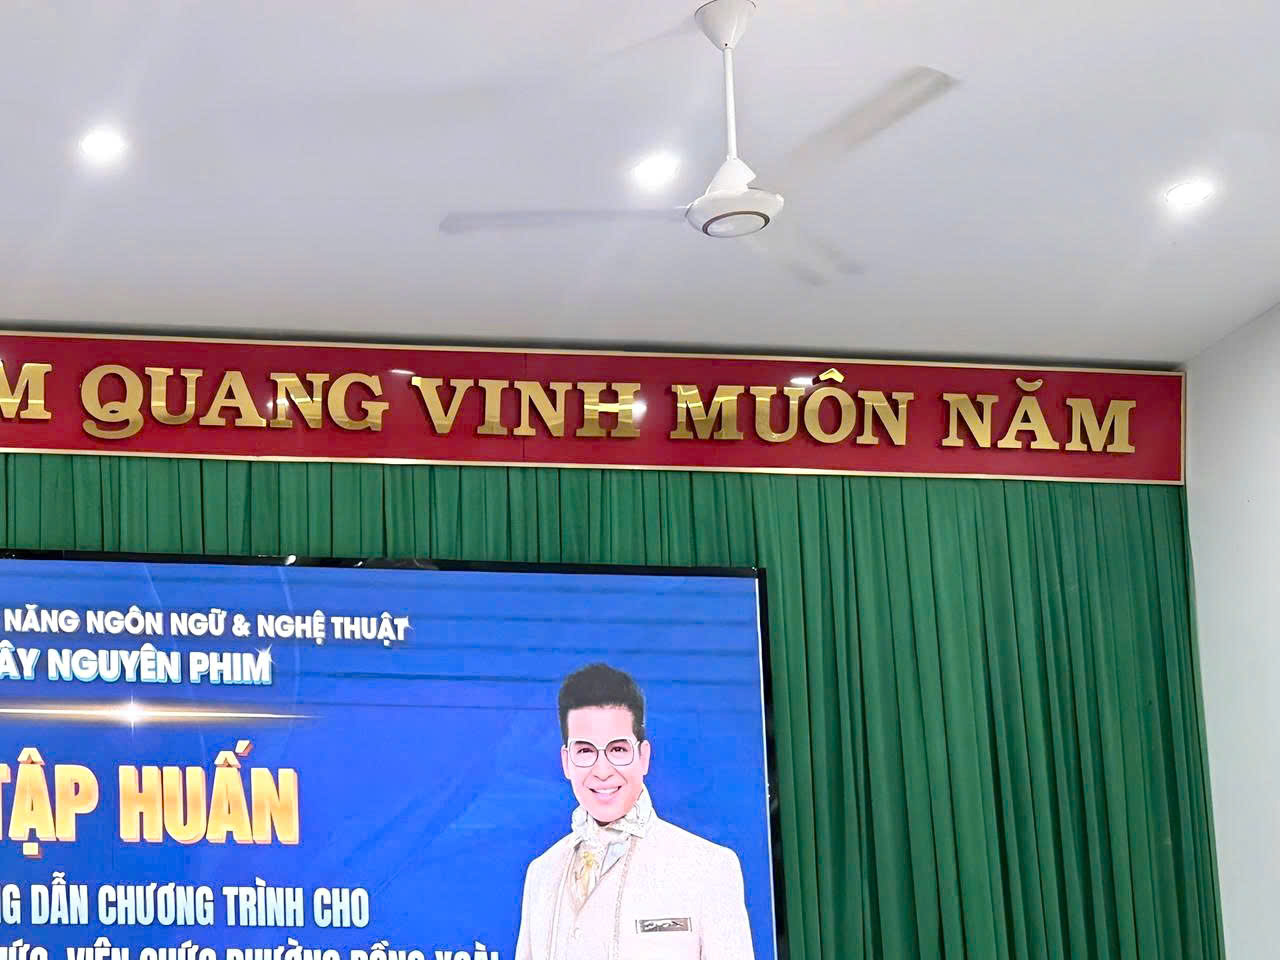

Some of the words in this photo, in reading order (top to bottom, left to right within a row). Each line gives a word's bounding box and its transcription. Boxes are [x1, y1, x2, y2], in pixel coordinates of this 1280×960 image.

[79, 364, 386, 439] QUANG
[412, 376, 641, 440] VINH
[670, 369, 914, 446] MUÔN
[941, 377, 1137, 454] NĂM
[5, 604, 80, 634] NĂNG
[87, 605, 164, 636] NGÔN
[170, 608, 227, 637] NGỮ
[232, 614, 251, 637] &
[257, 610, 326, 646] NGHỆ
[331, 611, 408, 647] THUẬT
[47, 643, 181, 684] NGUYÊN
[189, 650, 273, 685] PHIM
[117, 739, 299, 845] HUẤN
[31, 872, 88, 926] DẪN
[98, 882, 214, 926] CHƯƠNG
[223, 876, 304, 928] TRÌNH
[313, 887, 370, 928] CHO
